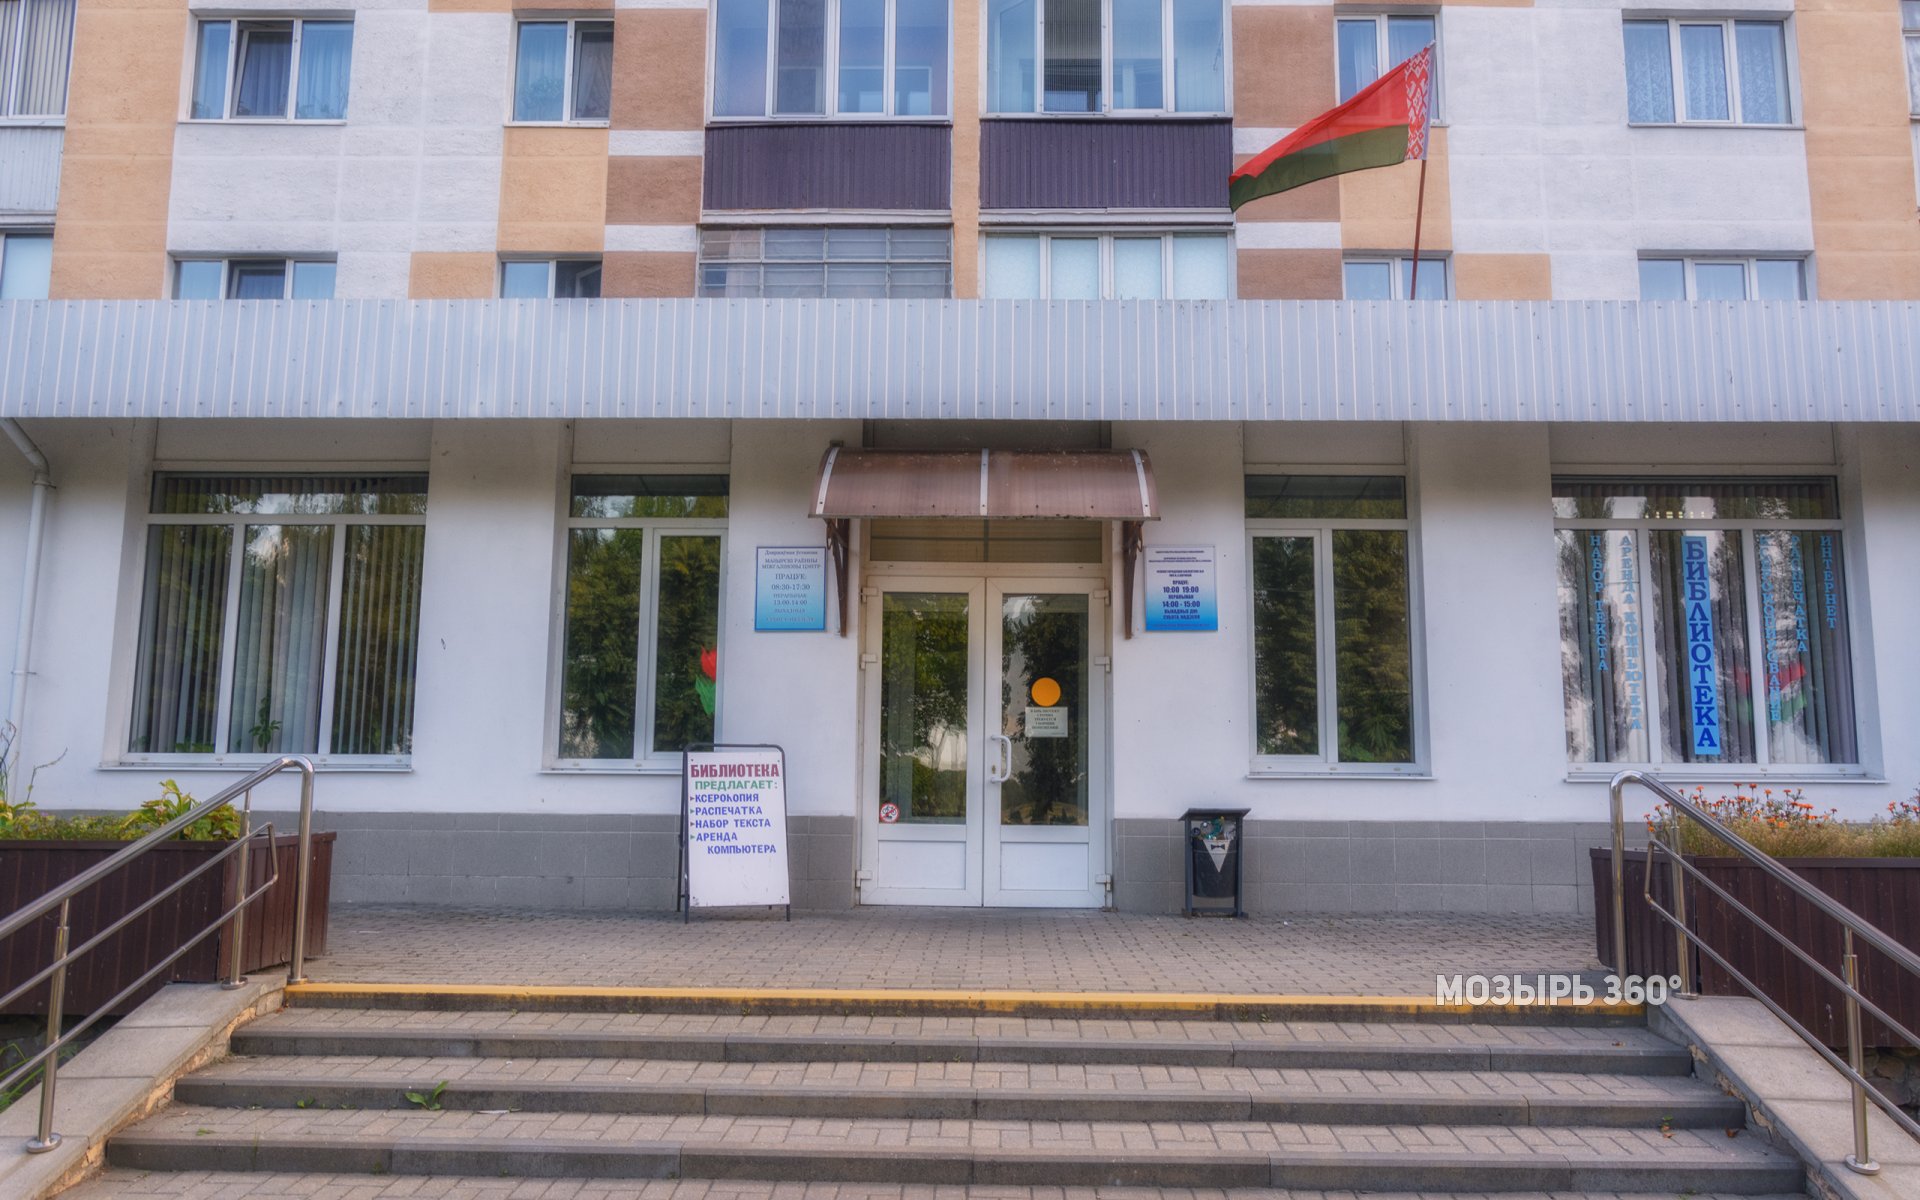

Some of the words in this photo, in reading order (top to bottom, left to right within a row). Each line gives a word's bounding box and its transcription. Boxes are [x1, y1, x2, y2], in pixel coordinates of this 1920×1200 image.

[1590, 535, 1604, 593] НАБОР
[1620, 535, 1635, 604] АРЕНДА
[1820, 535, 1838, 628] ИНТЕРНЕТ
[1791, 535, 1808, 652] РАСПЕЧАТКА
[1594, 600, 1608, 671] ТЕКСТА
[1685, 541, 1718, 747] БИБЛИОТЕКА
[1623, 612, 1642, 730] КОМПЬЮТЕРА
[690, 764, 779, 778] БИБЛИОТЕКА
[695, 780, 778, 791] ПРЕДЛАГАЕТ:
[695, 794, 759, 803] КСЕРОКОПИЯ
[695, 806, 763, 815] РАСПЕЧАТКА
[695, 819, 729, 828] НАБОР
[734, 819, 771, 828] ТЕКСТА
[696, 832, 738, 842] АРЕНДА
[707, 845, 776, 854] КОМПЬЮТЕРА
